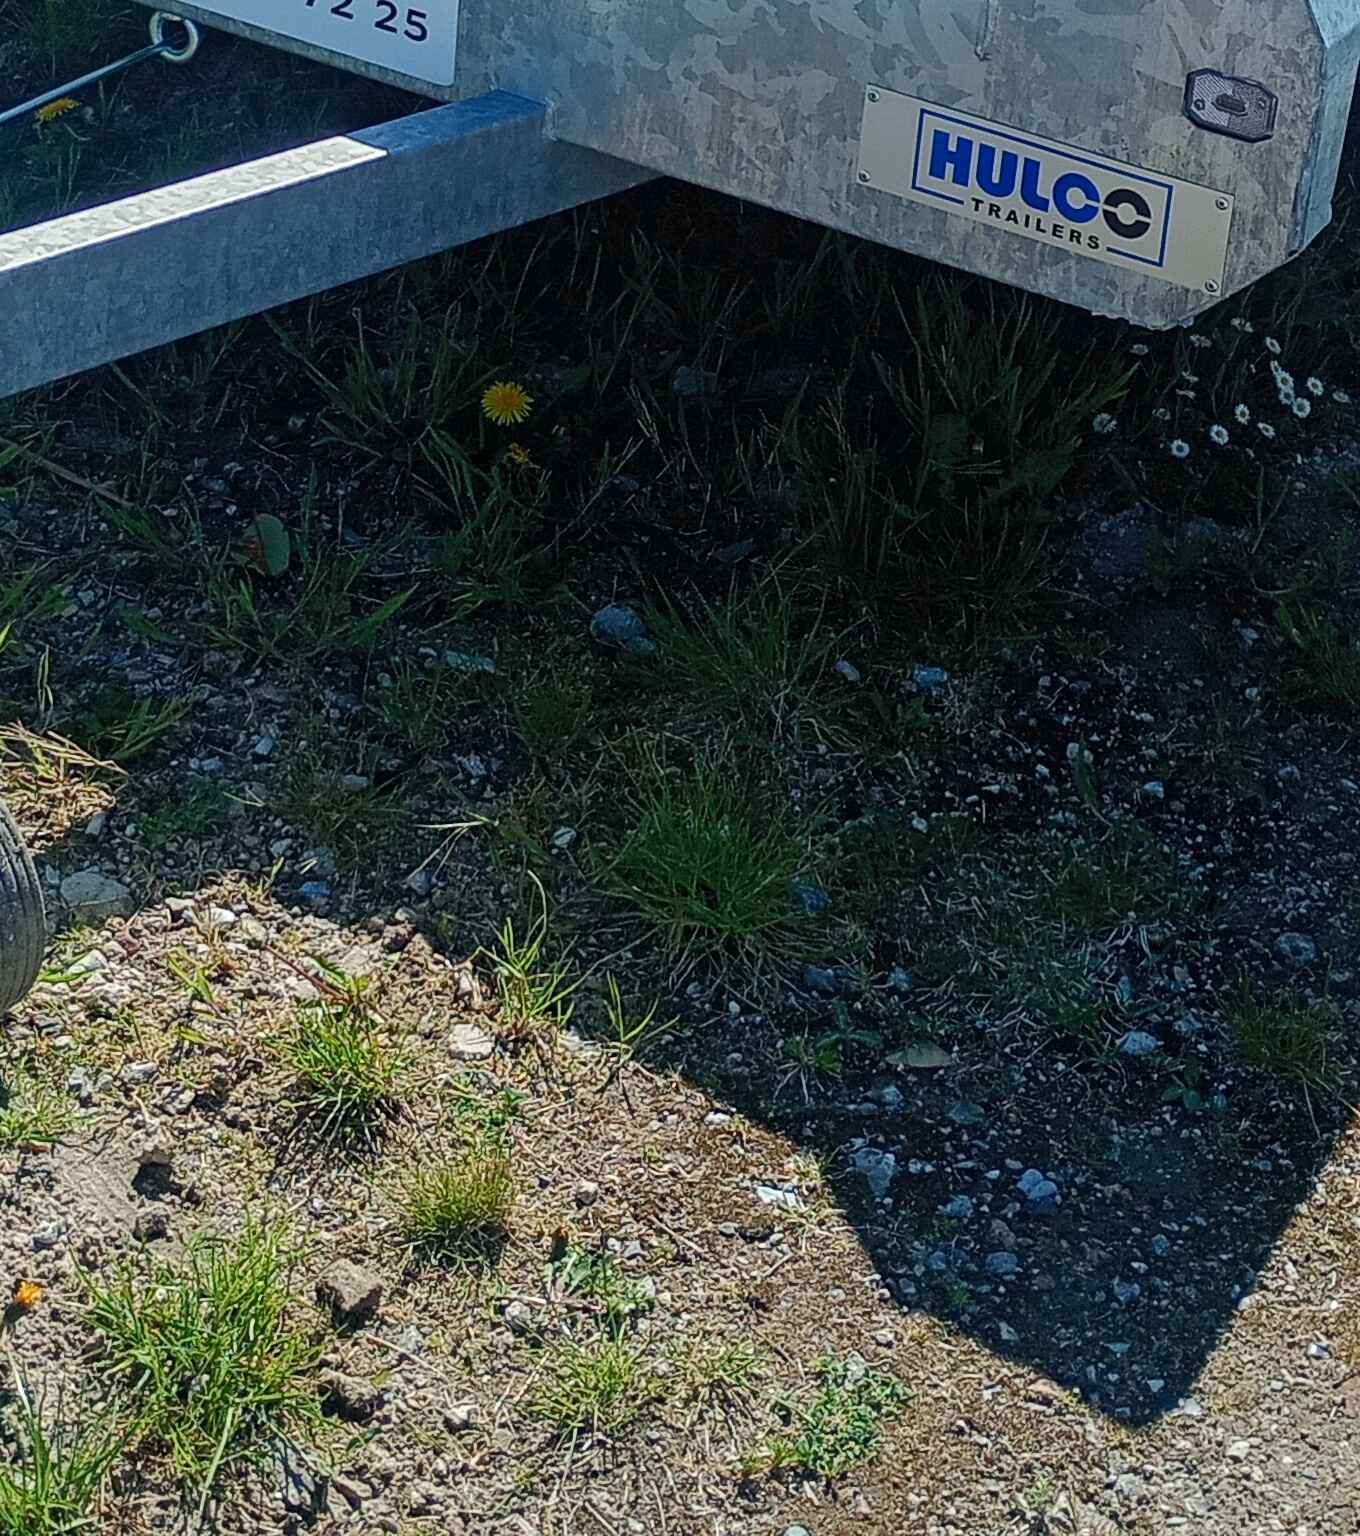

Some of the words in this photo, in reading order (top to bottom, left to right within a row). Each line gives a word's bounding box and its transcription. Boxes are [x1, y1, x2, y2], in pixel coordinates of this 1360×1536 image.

[374, 0, 430, 42] 25
[929, 129, 1152, 239] HULCO
[971, 197, 1101, 250] TRAILERS
